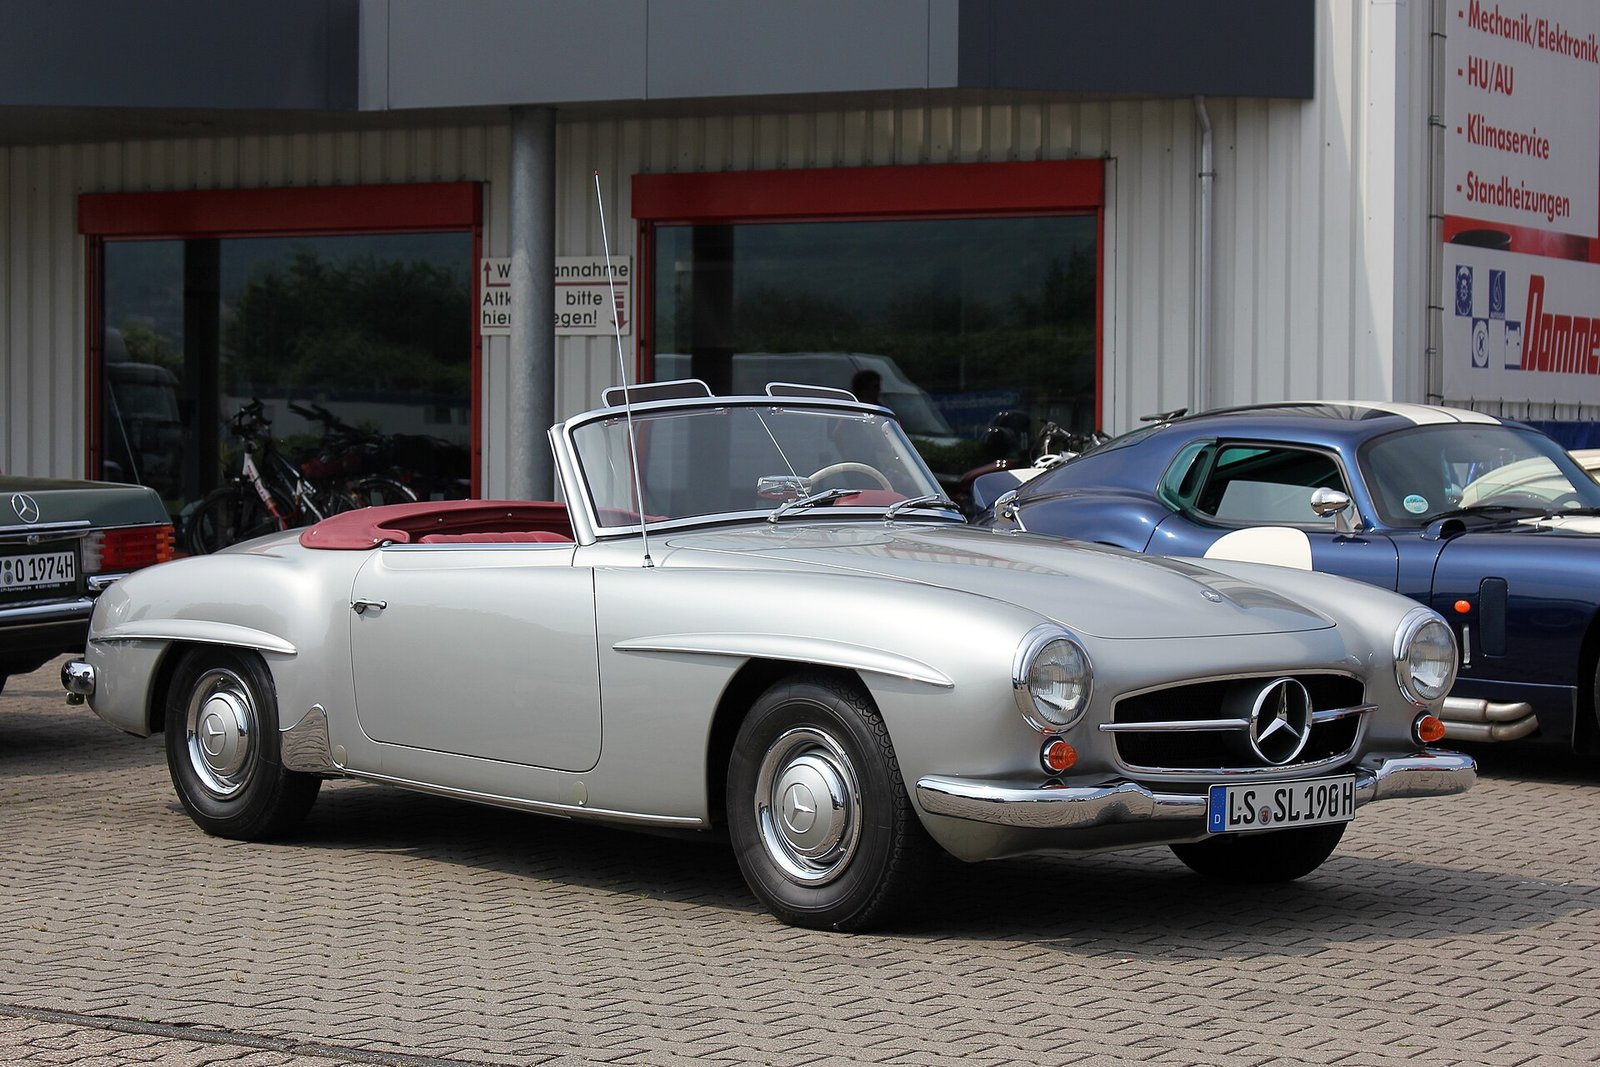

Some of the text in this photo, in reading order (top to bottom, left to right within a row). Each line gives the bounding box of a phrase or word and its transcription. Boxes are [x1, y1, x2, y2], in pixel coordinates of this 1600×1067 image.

[1468, 0, 1599, 64] Mechanik/Elektronik
[1468, 55, 1514, 96] HU/AU
[1467, 113, 1550, 160] Klimaservice
[1466, 170, 1570, 222] Standheizungen
[483, 290, 603, 306] Altk bitte
[554, 309, 597, 328] egen!
[1520, 274, 1600, 375] Domme
[28, 555, 74, 581] 1974H
[1214, 814, 1221, 824] D
[1229, 790, 1256, 825] LS
[1273, 788, 1300, 822] SL
